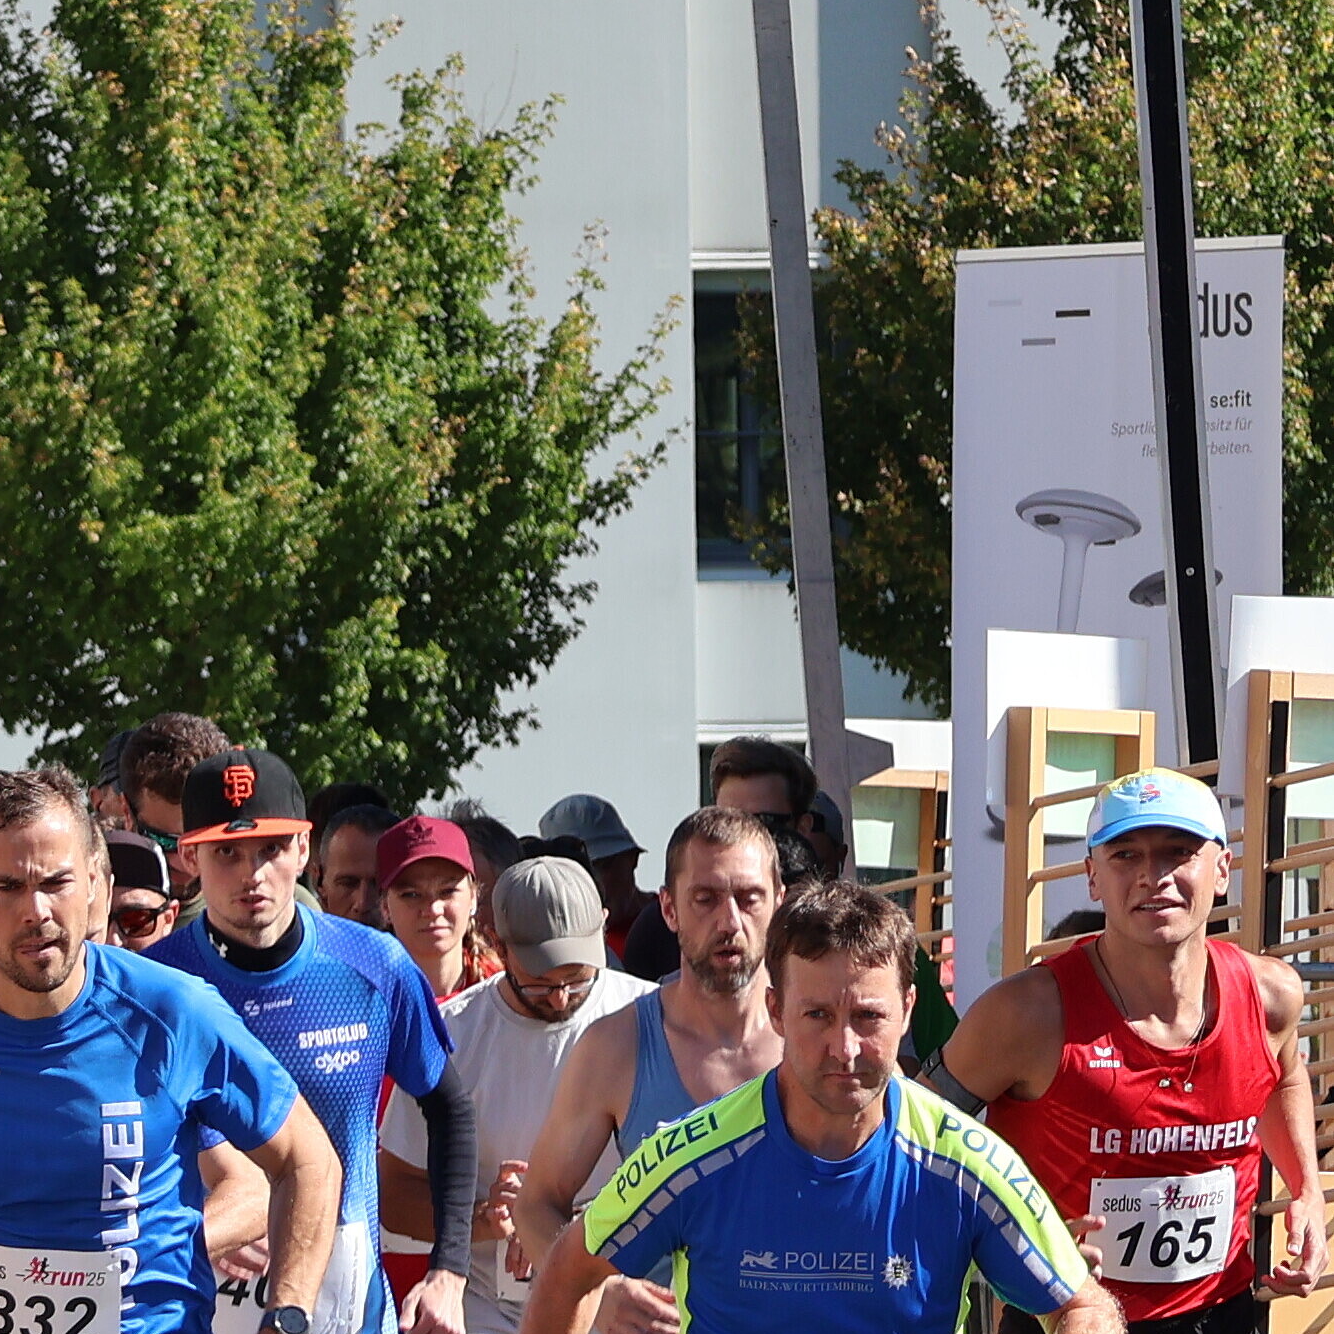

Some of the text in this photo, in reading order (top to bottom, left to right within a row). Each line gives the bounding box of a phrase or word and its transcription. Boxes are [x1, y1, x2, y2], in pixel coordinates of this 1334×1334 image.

[1197, 282, 1253, 338] dus
[1210, 389, 1252, 408] se:fit
[1235, 416, 1253, 430] für
[298, 1022, 369, 1049] SPORTCLUB
[1090, 1116, 1258, 1155] LG HOHENFELS
[616, 1111, 719, 1204] POLIZEI
[937, 1112, 1048, 1224] POLIZEI
[1102, 1195, 1142, 1213] sedus
[1116, 1216, 1217, 1268] 165
[785, 1251, 875, 1271] POLIZEI
